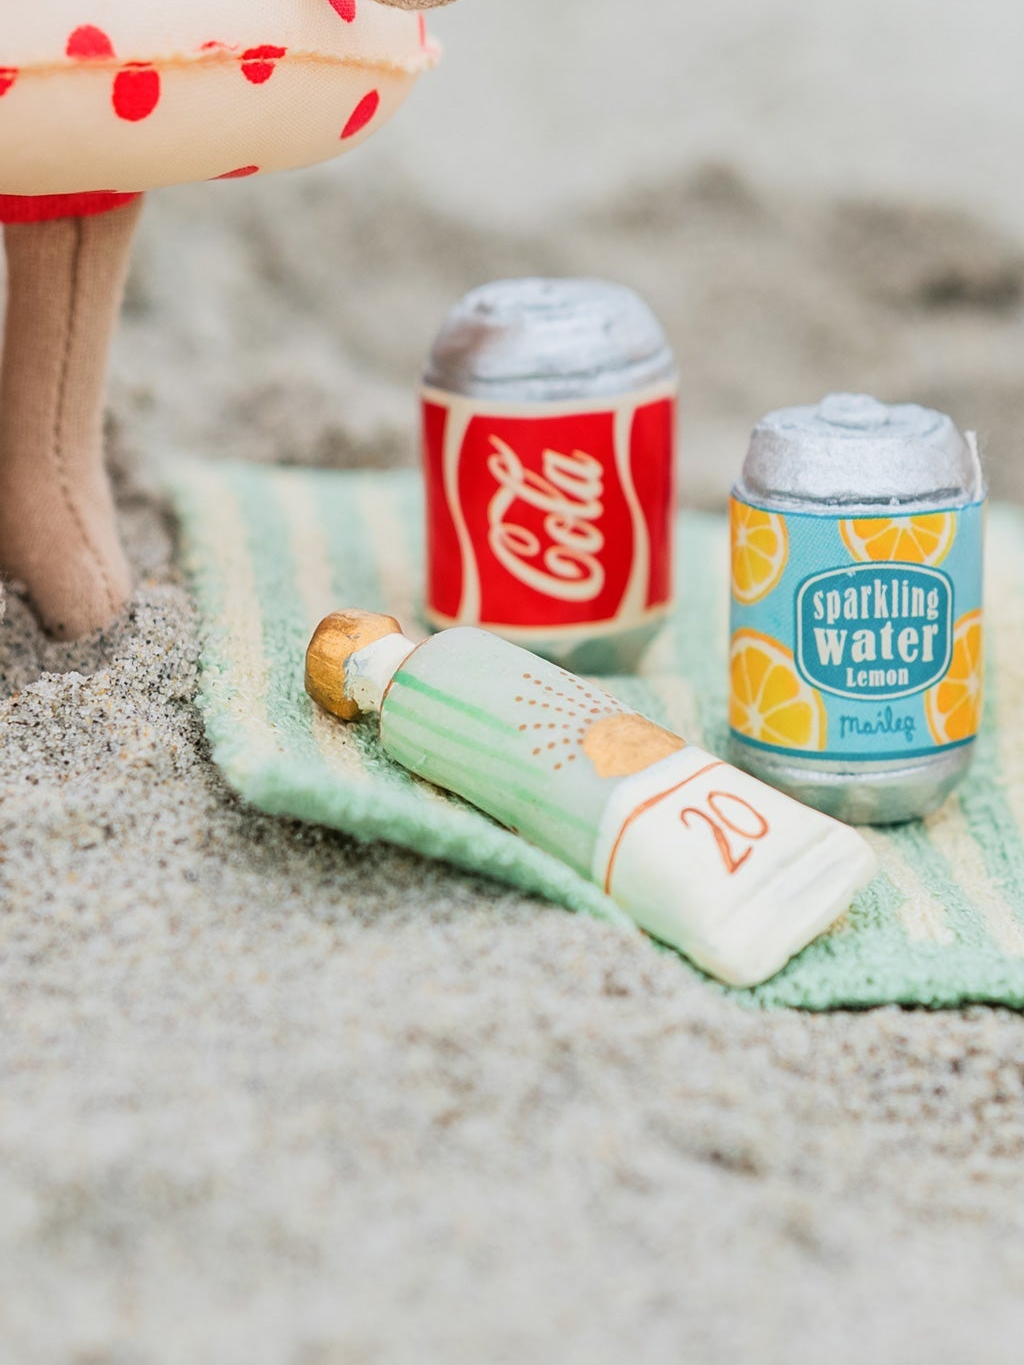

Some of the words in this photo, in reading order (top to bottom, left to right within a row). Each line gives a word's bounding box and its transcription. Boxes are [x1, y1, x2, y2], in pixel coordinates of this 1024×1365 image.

[487, 434, 604, 602] Cola
[813, 579, 939, 625] sparkling
[846, 668, 909, 688] Lemon
[840, 705, 916, 742] maileg
[680, 790, 769, 875] 20
